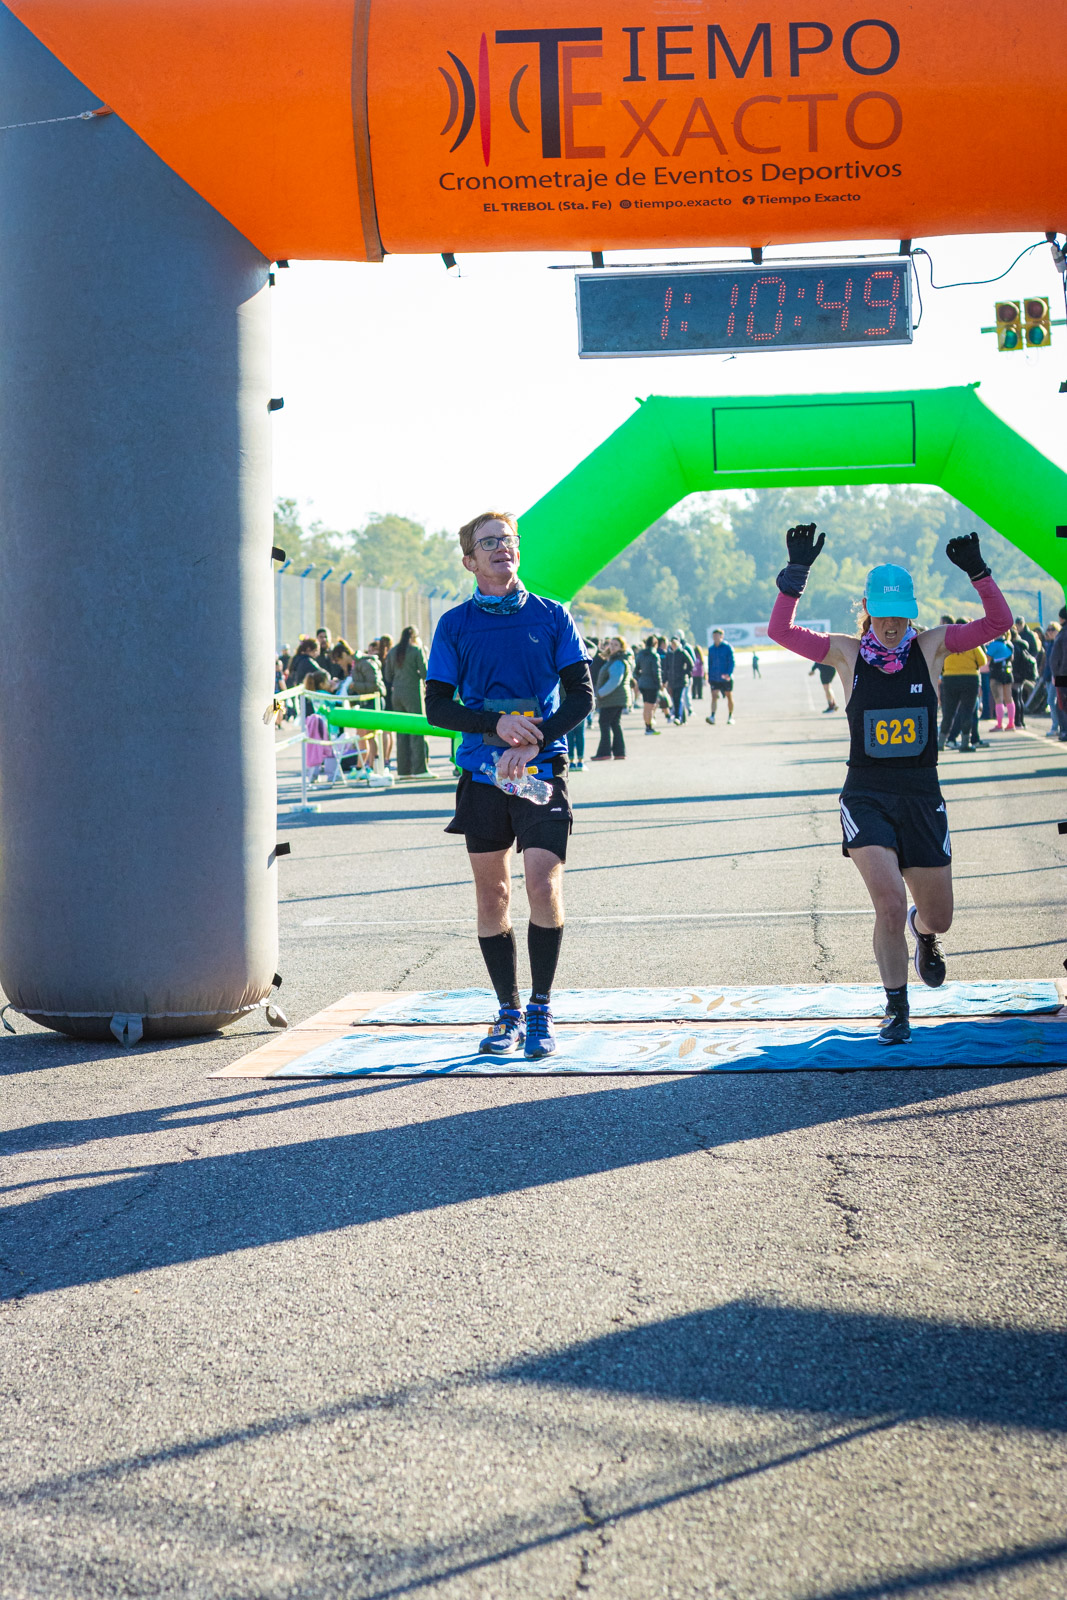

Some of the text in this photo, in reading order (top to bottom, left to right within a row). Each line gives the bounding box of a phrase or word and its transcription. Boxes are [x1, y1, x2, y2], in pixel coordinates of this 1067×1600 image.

[439, 160, 903, 192] Cronometraje de Eventos Deportivos
[483, 193, 862, 213] EL TREBOL (Sta. Fe) tiempo.exacto Tiempo Exacto
[875, 718, 917, 745] 623
